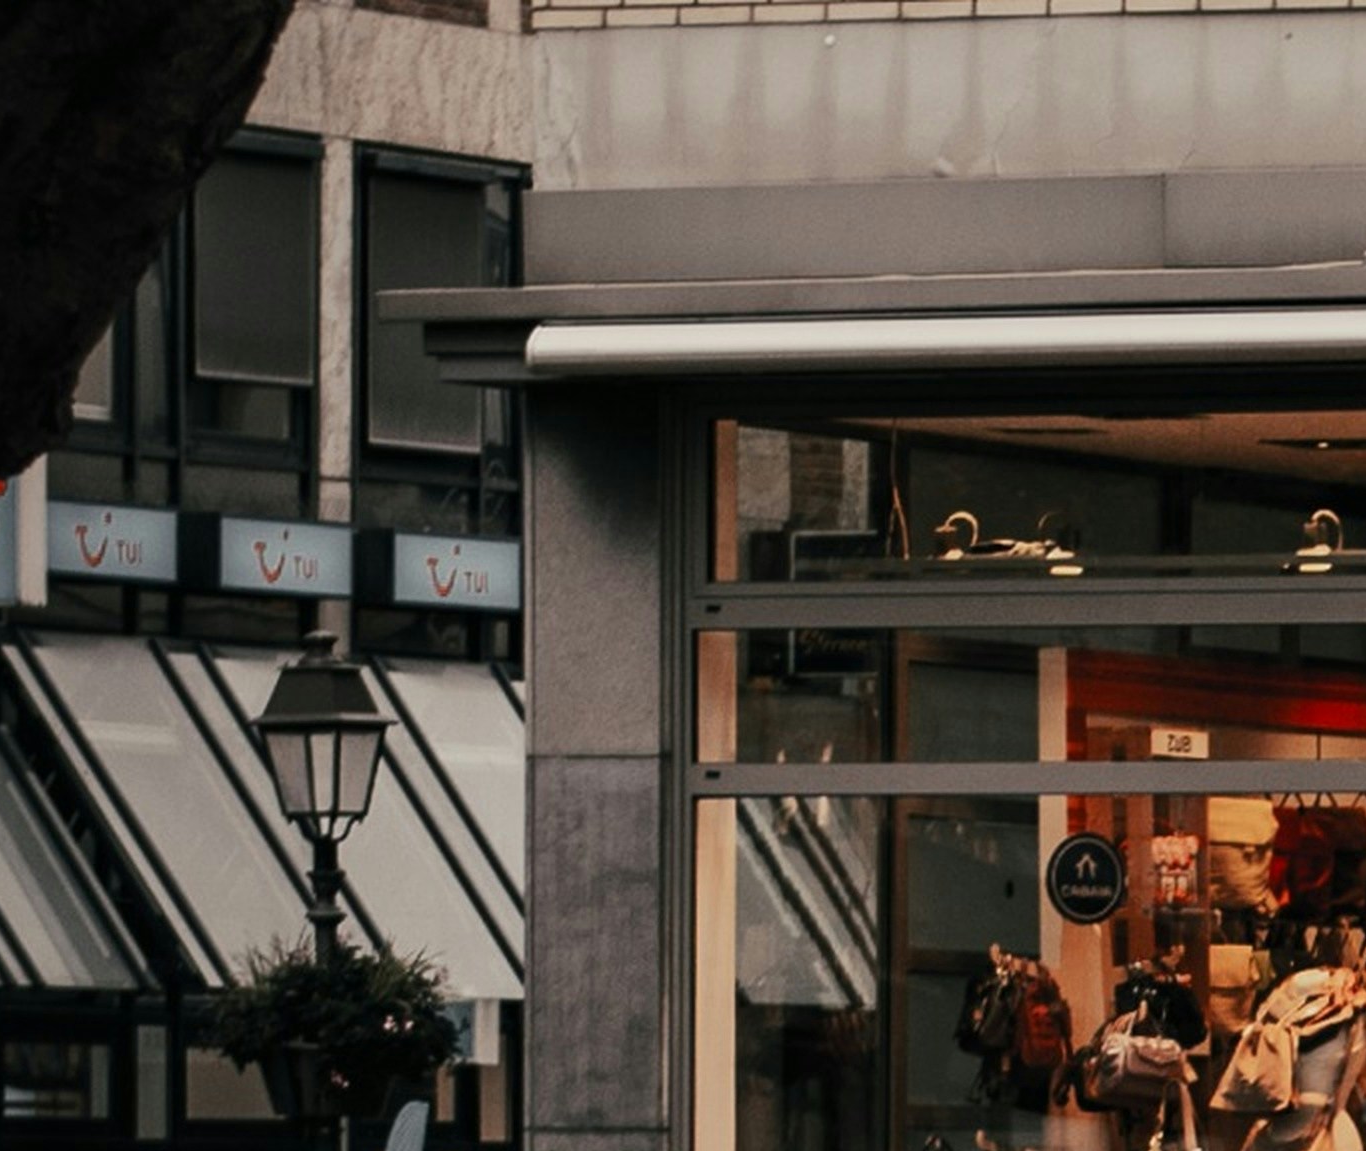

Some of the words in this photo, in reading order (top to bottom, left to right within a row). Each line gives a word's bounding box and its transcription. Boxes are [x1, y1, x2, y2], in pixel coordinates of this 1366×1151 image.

[115, 539, 143, 565] TUI
[293, 555, 320, 580] TUI
[463, 571, 490, 594] TUI
